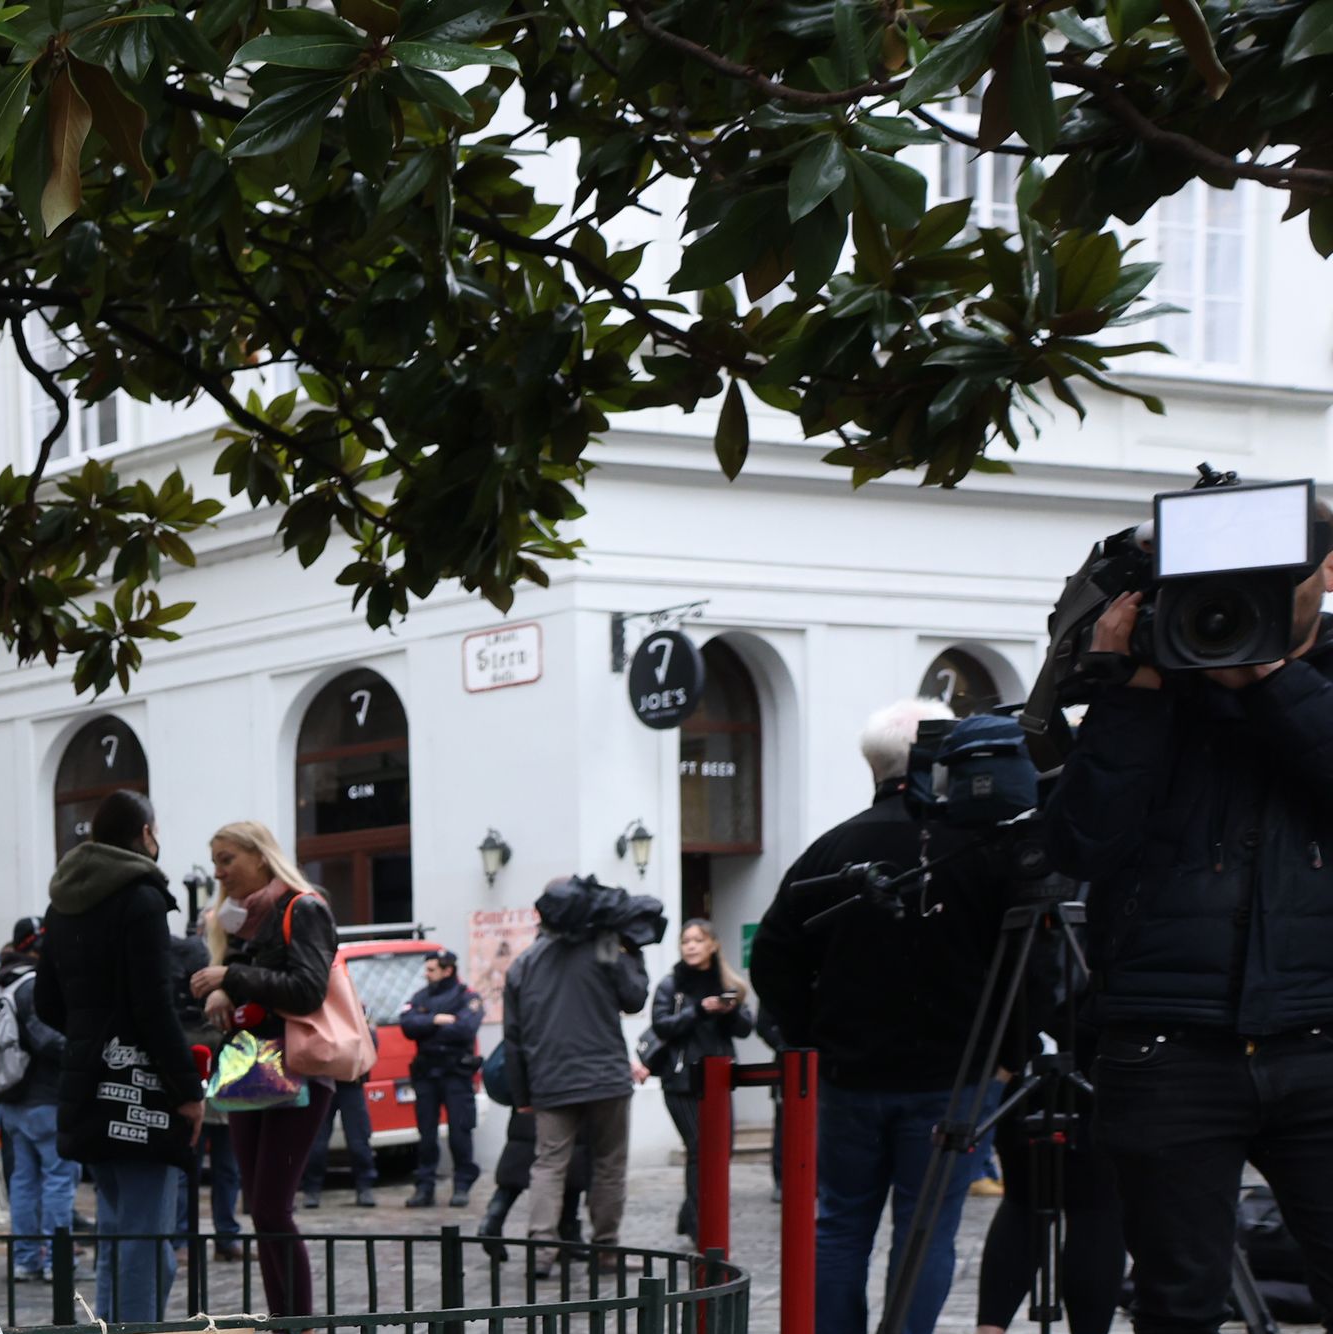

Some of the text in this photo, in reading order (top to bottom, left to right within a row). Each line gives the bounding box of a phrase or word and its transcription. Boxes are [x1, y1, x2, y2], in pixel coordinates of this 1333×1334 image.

[638, 688, 687, 712] JOE'S
[701, 761, 736, 777] BEER
[347, 782, 375, 800] GIN
[100, 1086, 138, 1100] MUSIC
[113, 1126, 148, 1140] FROM
